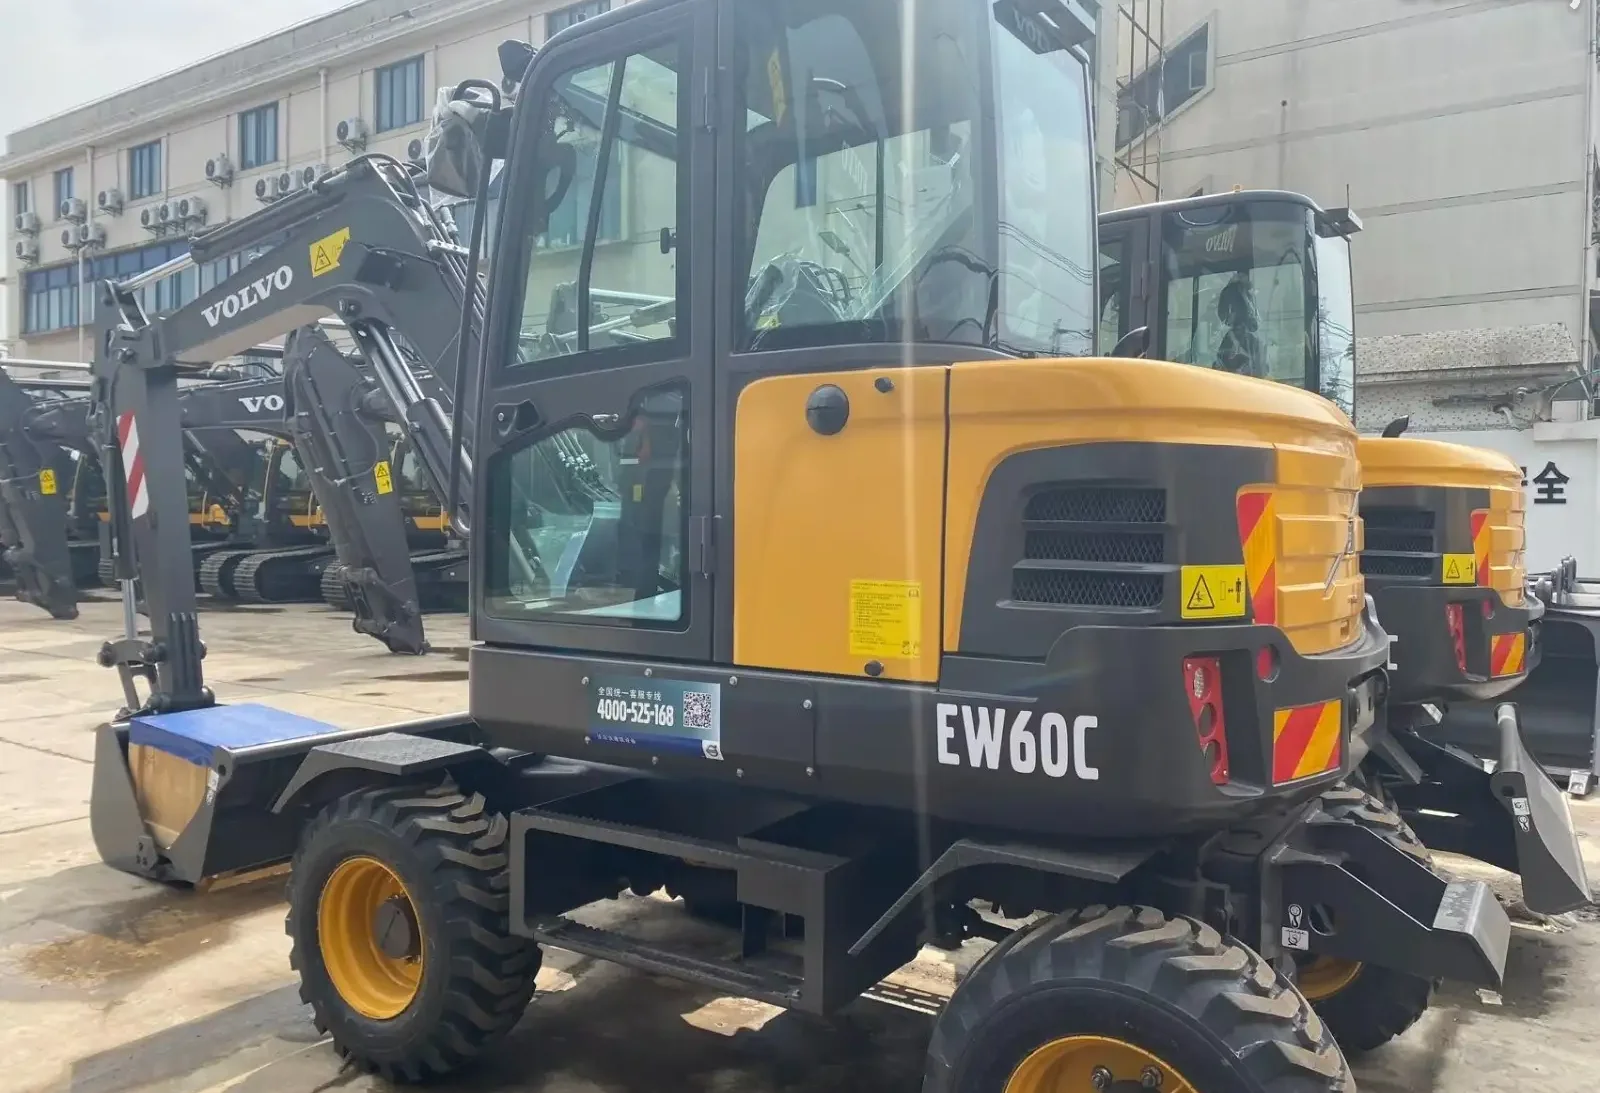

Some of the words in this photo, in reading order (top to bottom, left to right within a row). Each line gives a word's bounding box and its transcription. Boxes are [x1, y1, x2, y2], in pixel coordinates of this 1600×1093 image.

[201, 265, 293, 328] VOLVO
[1520, 461, 1570, 504] 全
[597, 686, 663, 702] 全国统一客服专线
[597, 699, 674, 727] 4000-525-168
[936, 702, 1099, 780] EW60C
